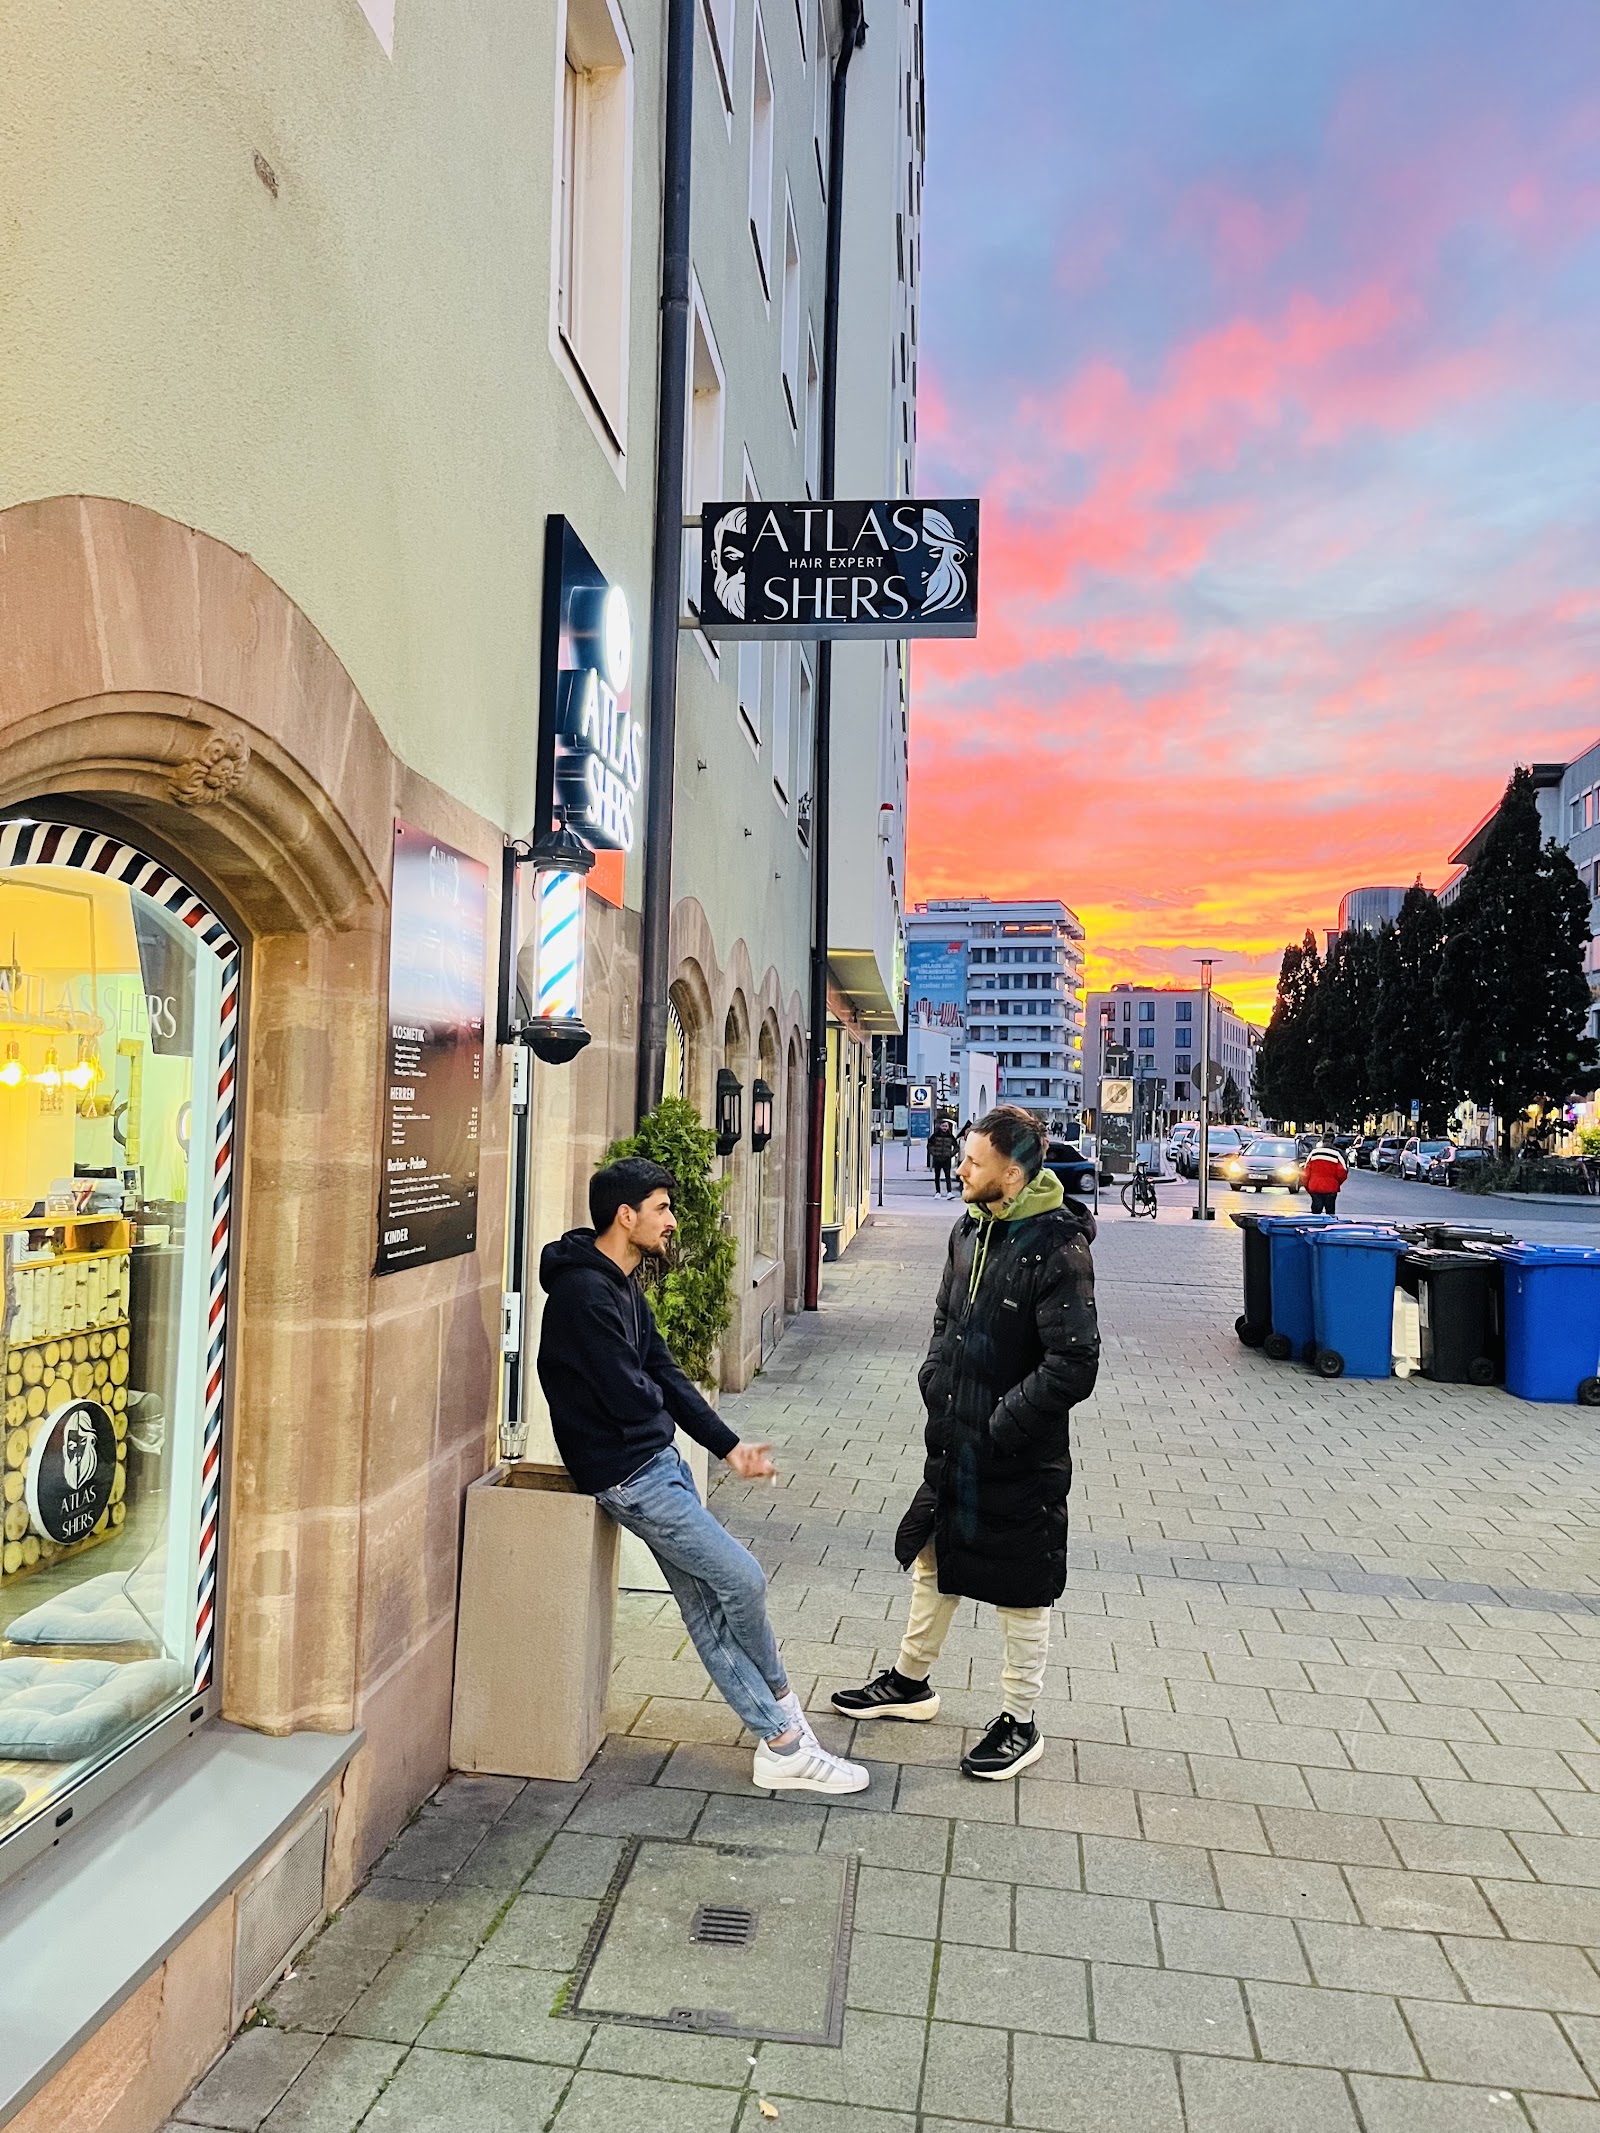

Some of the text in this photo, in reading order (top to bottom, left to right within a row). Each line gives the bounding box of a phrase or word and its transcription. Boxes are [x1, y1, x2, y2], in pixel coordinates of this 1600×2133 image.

[752, 507, 919, 552] ATLAS
[789, 556, 884, 569] HAIR EXPERT
[763, 575, 909, 620] SHERS
[581, 667, 643, 797] ATLAS
[586, 752, 635, 853] SHERS
[0, 968, 177, 1039] ATLAS SHERS
[392, 1025, 425, 1043] KOSMETIK
[390, 1086, 416, 1101] HERREN
[384, 1228, 409, 1246] KINDER
[60, 1484, 97, 1515] ATLAS
[62, 1510, 94, 1539] SHERS
